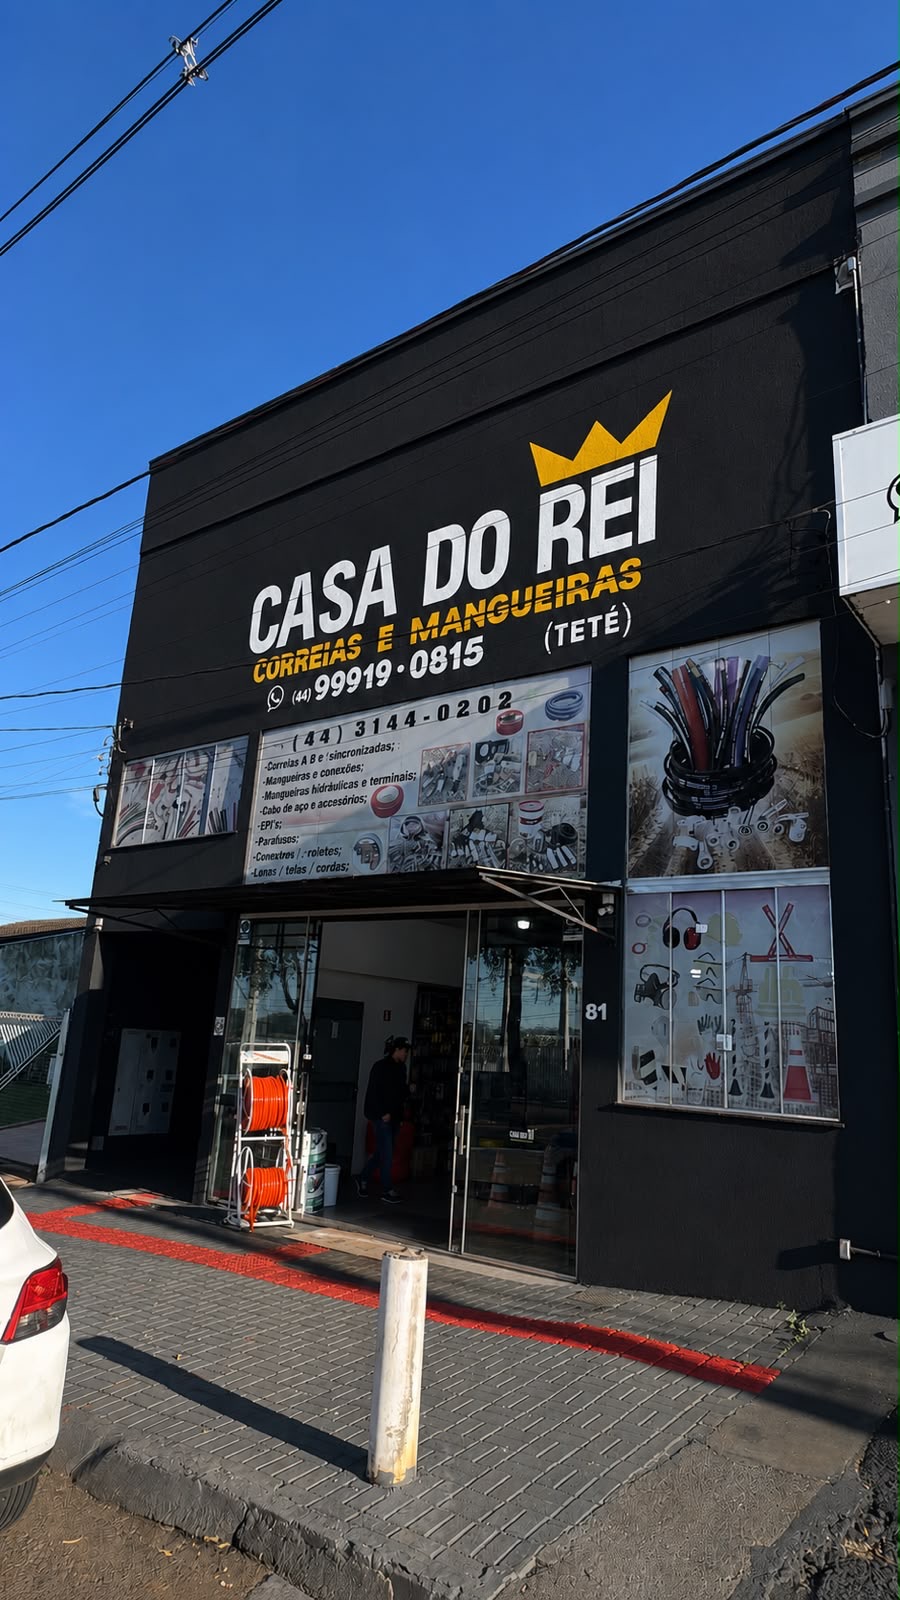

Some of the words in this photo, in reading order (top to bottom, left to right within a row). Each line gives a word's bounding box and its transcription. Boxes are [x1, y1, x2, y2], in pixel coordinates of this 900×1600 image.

[248, 545, 398, 655] CASA
[423, 509, 511, 607] DO
[536, 454, 658, 574] REI
[252, 633, 363, 684] CORREIAS
[376, 624, 395, 653] E
[410, 557, 643, 645] MANGUEIRAS
[543, 602, 632, 656] (TETÉ)
[292, 687, 312, 705] (44)
[292, 724, 343, 753] (44)
[354, 690, 513, 738] 3144-0202
[301, 755, 307, 766] A
[309, 753, 317, 764] B
[317, 754, 324, 763] e
[312, 770, 318, 779] e
[361, 778, 368, 788] e
[369, 770, 417, 786] terminais;
[282, 803, 293, 813] de
[294, 803, 309, 813] aço
[310, 801, 316, 810] e
[285, 864, 307, 875] telas
[315, 861, 350, 873] cordas;
[585, 1003, 607, 1021] 81
